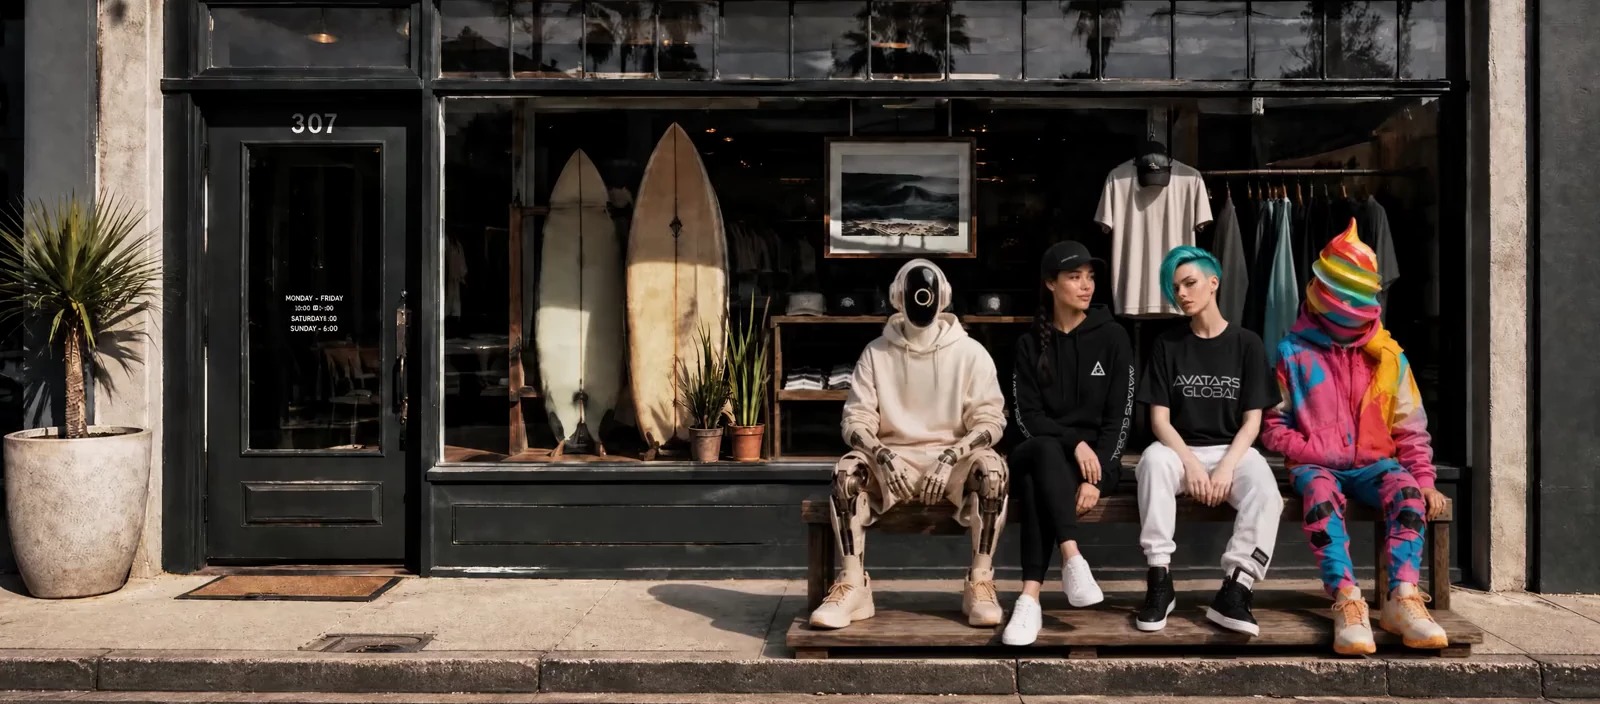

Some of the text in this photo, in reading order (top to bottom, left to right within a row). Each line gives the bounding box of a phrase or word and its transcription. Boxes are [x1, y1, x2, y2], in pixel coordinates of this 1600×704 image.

[291, 113, 337, 134] 307
[1173, 375, 1240, 388] AVATARS
[1182, 386, 1237, 400] GLOBAL
[1110, 365, 1135, 461] AVATARS GLOBAL
